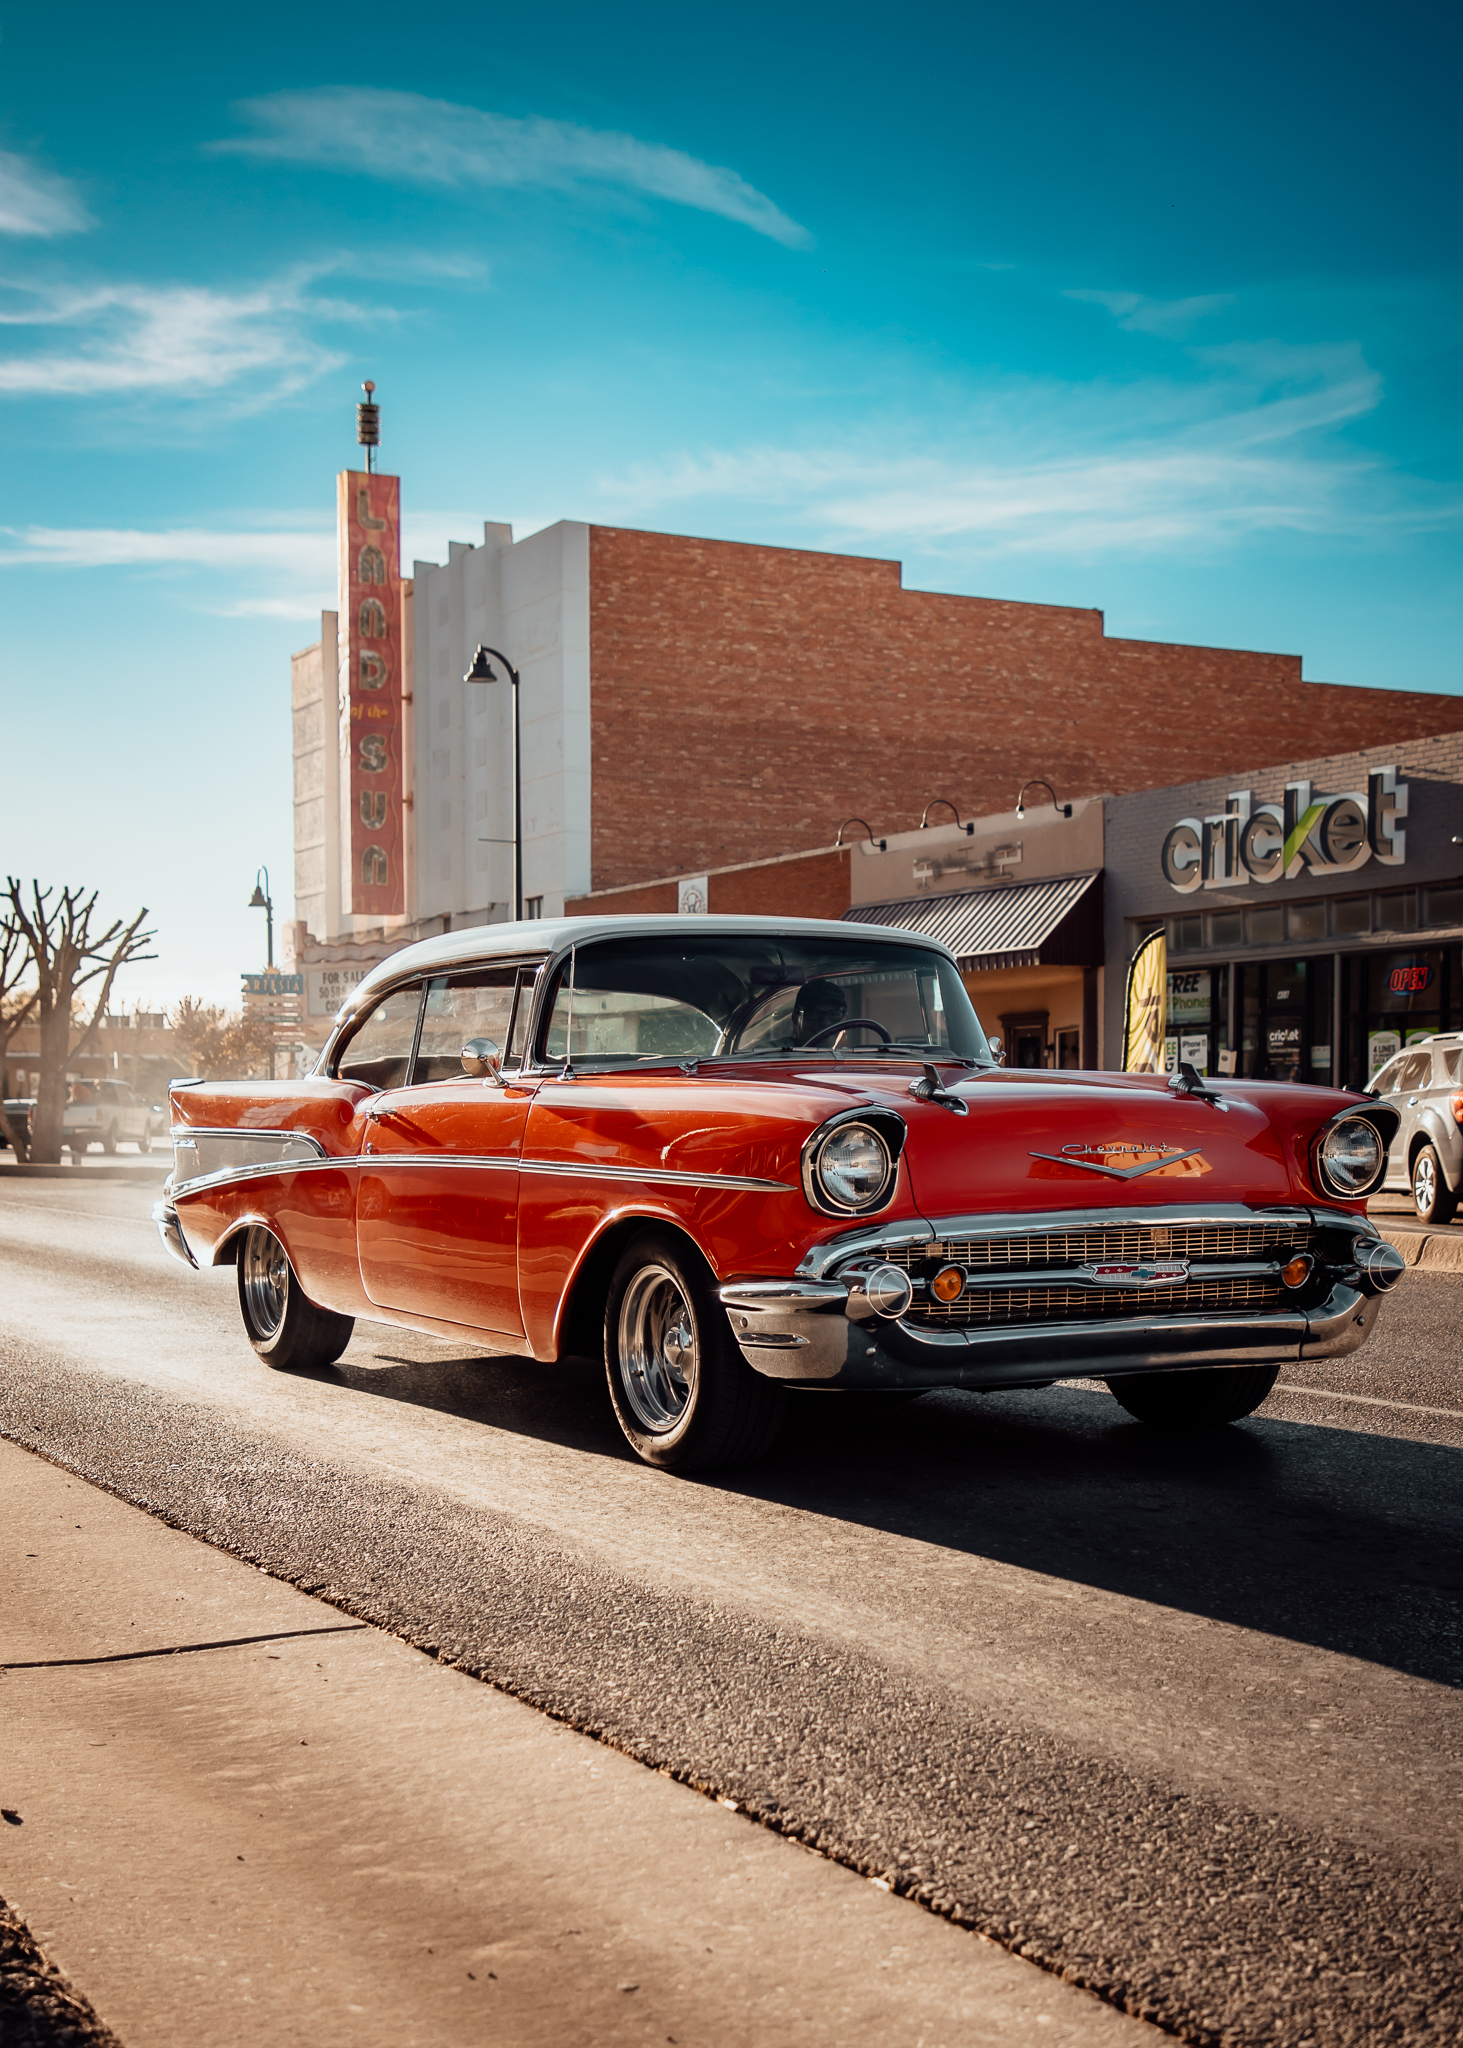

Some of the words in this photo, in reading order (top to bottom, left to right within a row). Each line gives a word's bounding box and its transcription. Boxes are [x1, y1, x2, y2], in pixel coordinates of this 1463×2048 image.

[358, 733, 388, 886] SUN
[1161, 764, 1409, 894] cricket
[322, 972, 340, 985] FOR
[343, 971, 365, 983] SALE
[1390, 966, 1428, 991] OPEN
[244, 979, 300, 992] ARTESIA
[1172, 996, 1211, 1010] Phones
[1269, 1029, 1299, 1041] cricket
[1061, 1142, 1176, 1155] Chevrolet
